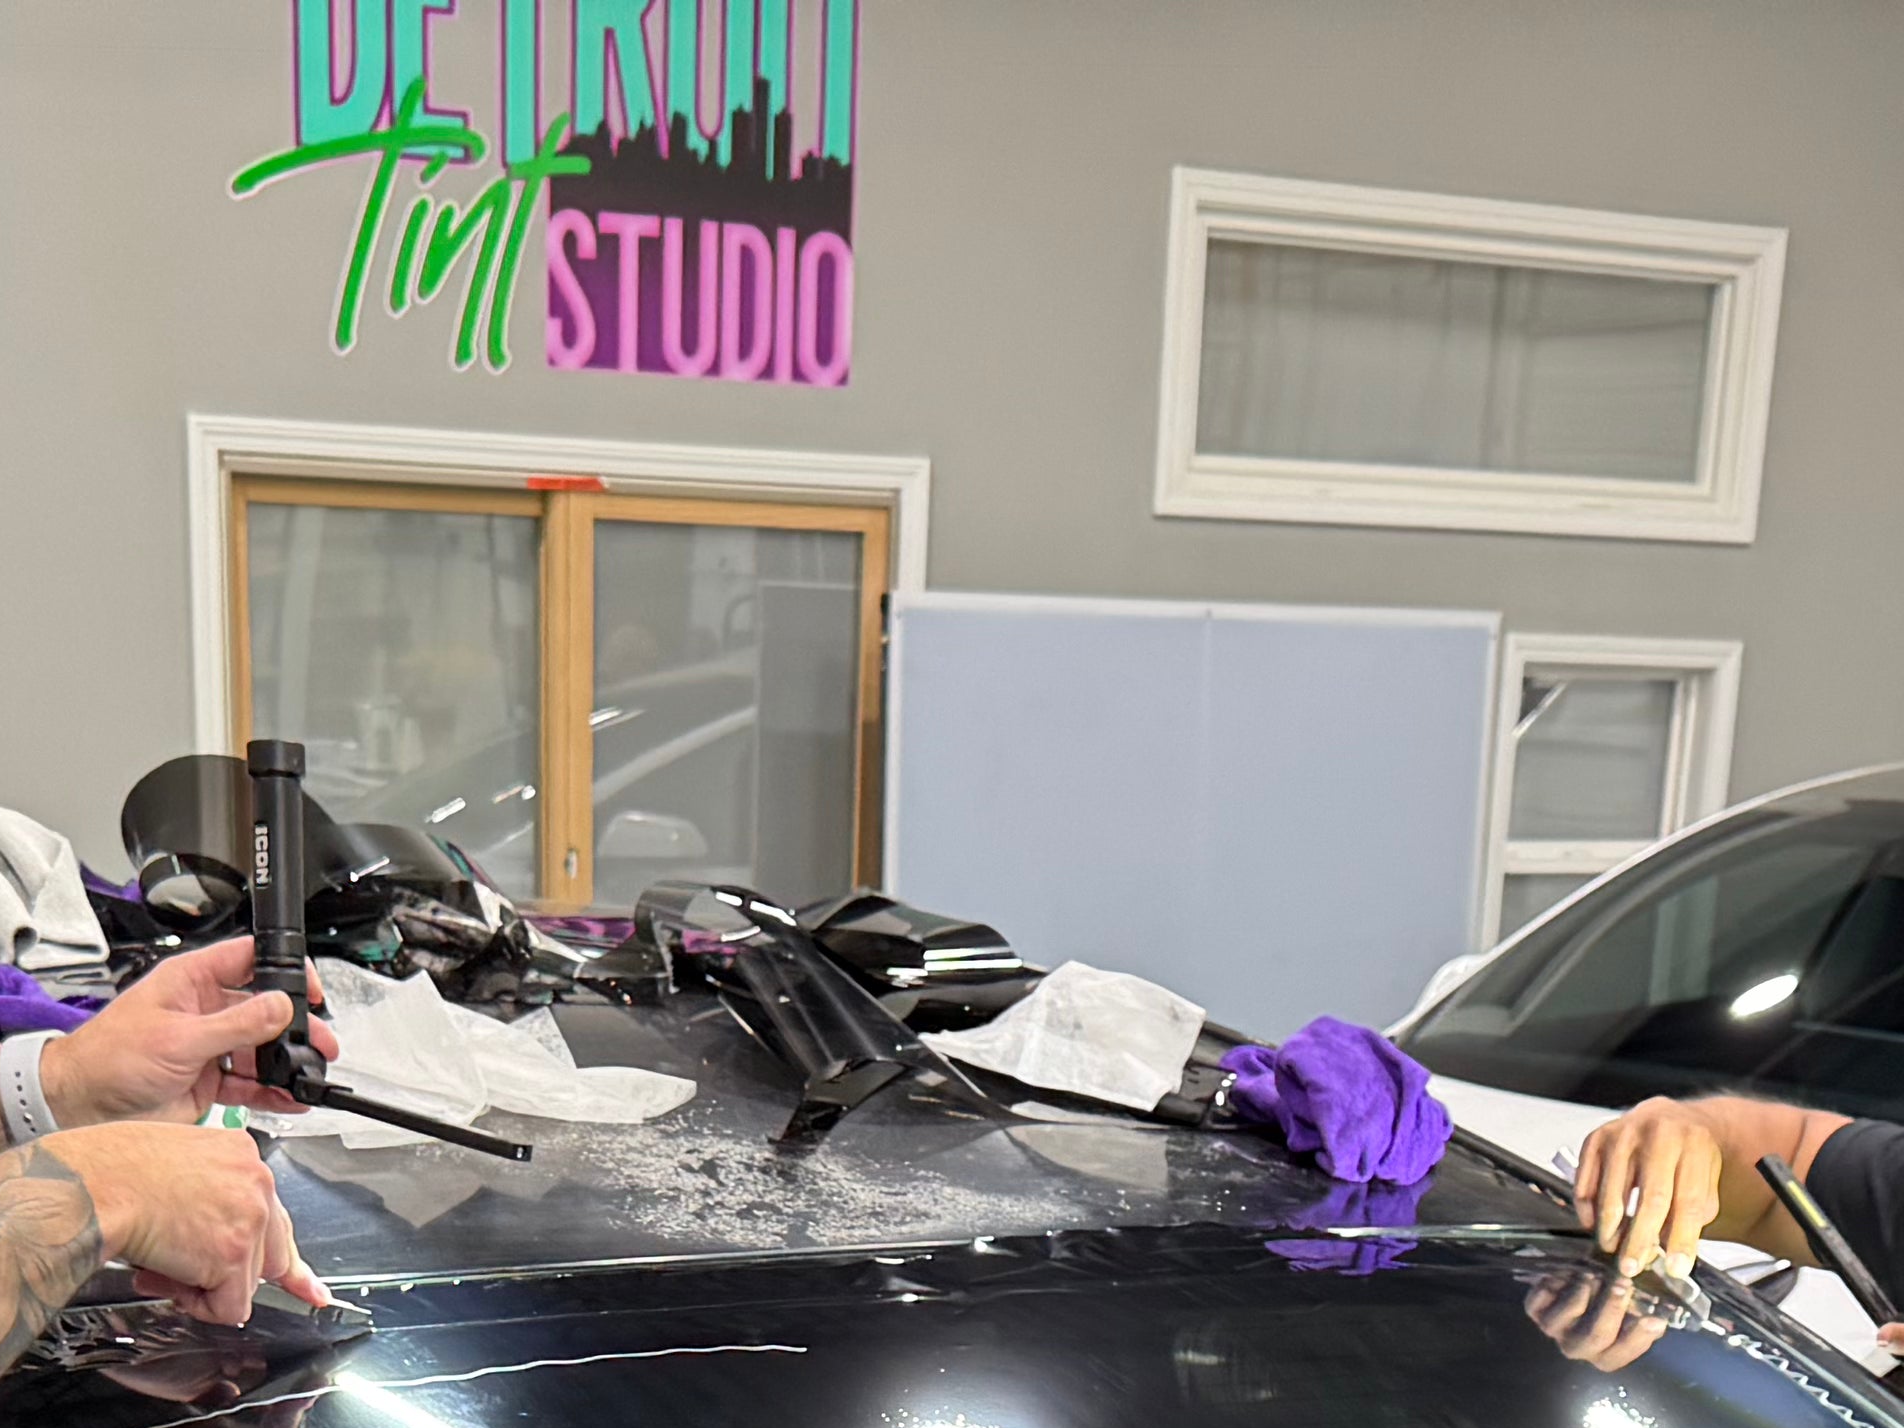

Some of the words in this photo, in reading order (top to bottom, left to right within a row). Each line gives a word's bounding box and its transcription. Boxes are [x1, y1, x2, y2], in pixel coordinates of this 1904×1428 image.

[230, 75, 592, 373] Tint
[547, 208, 853, 386] STUDIO
[254, 826, 269, 885] ICON
